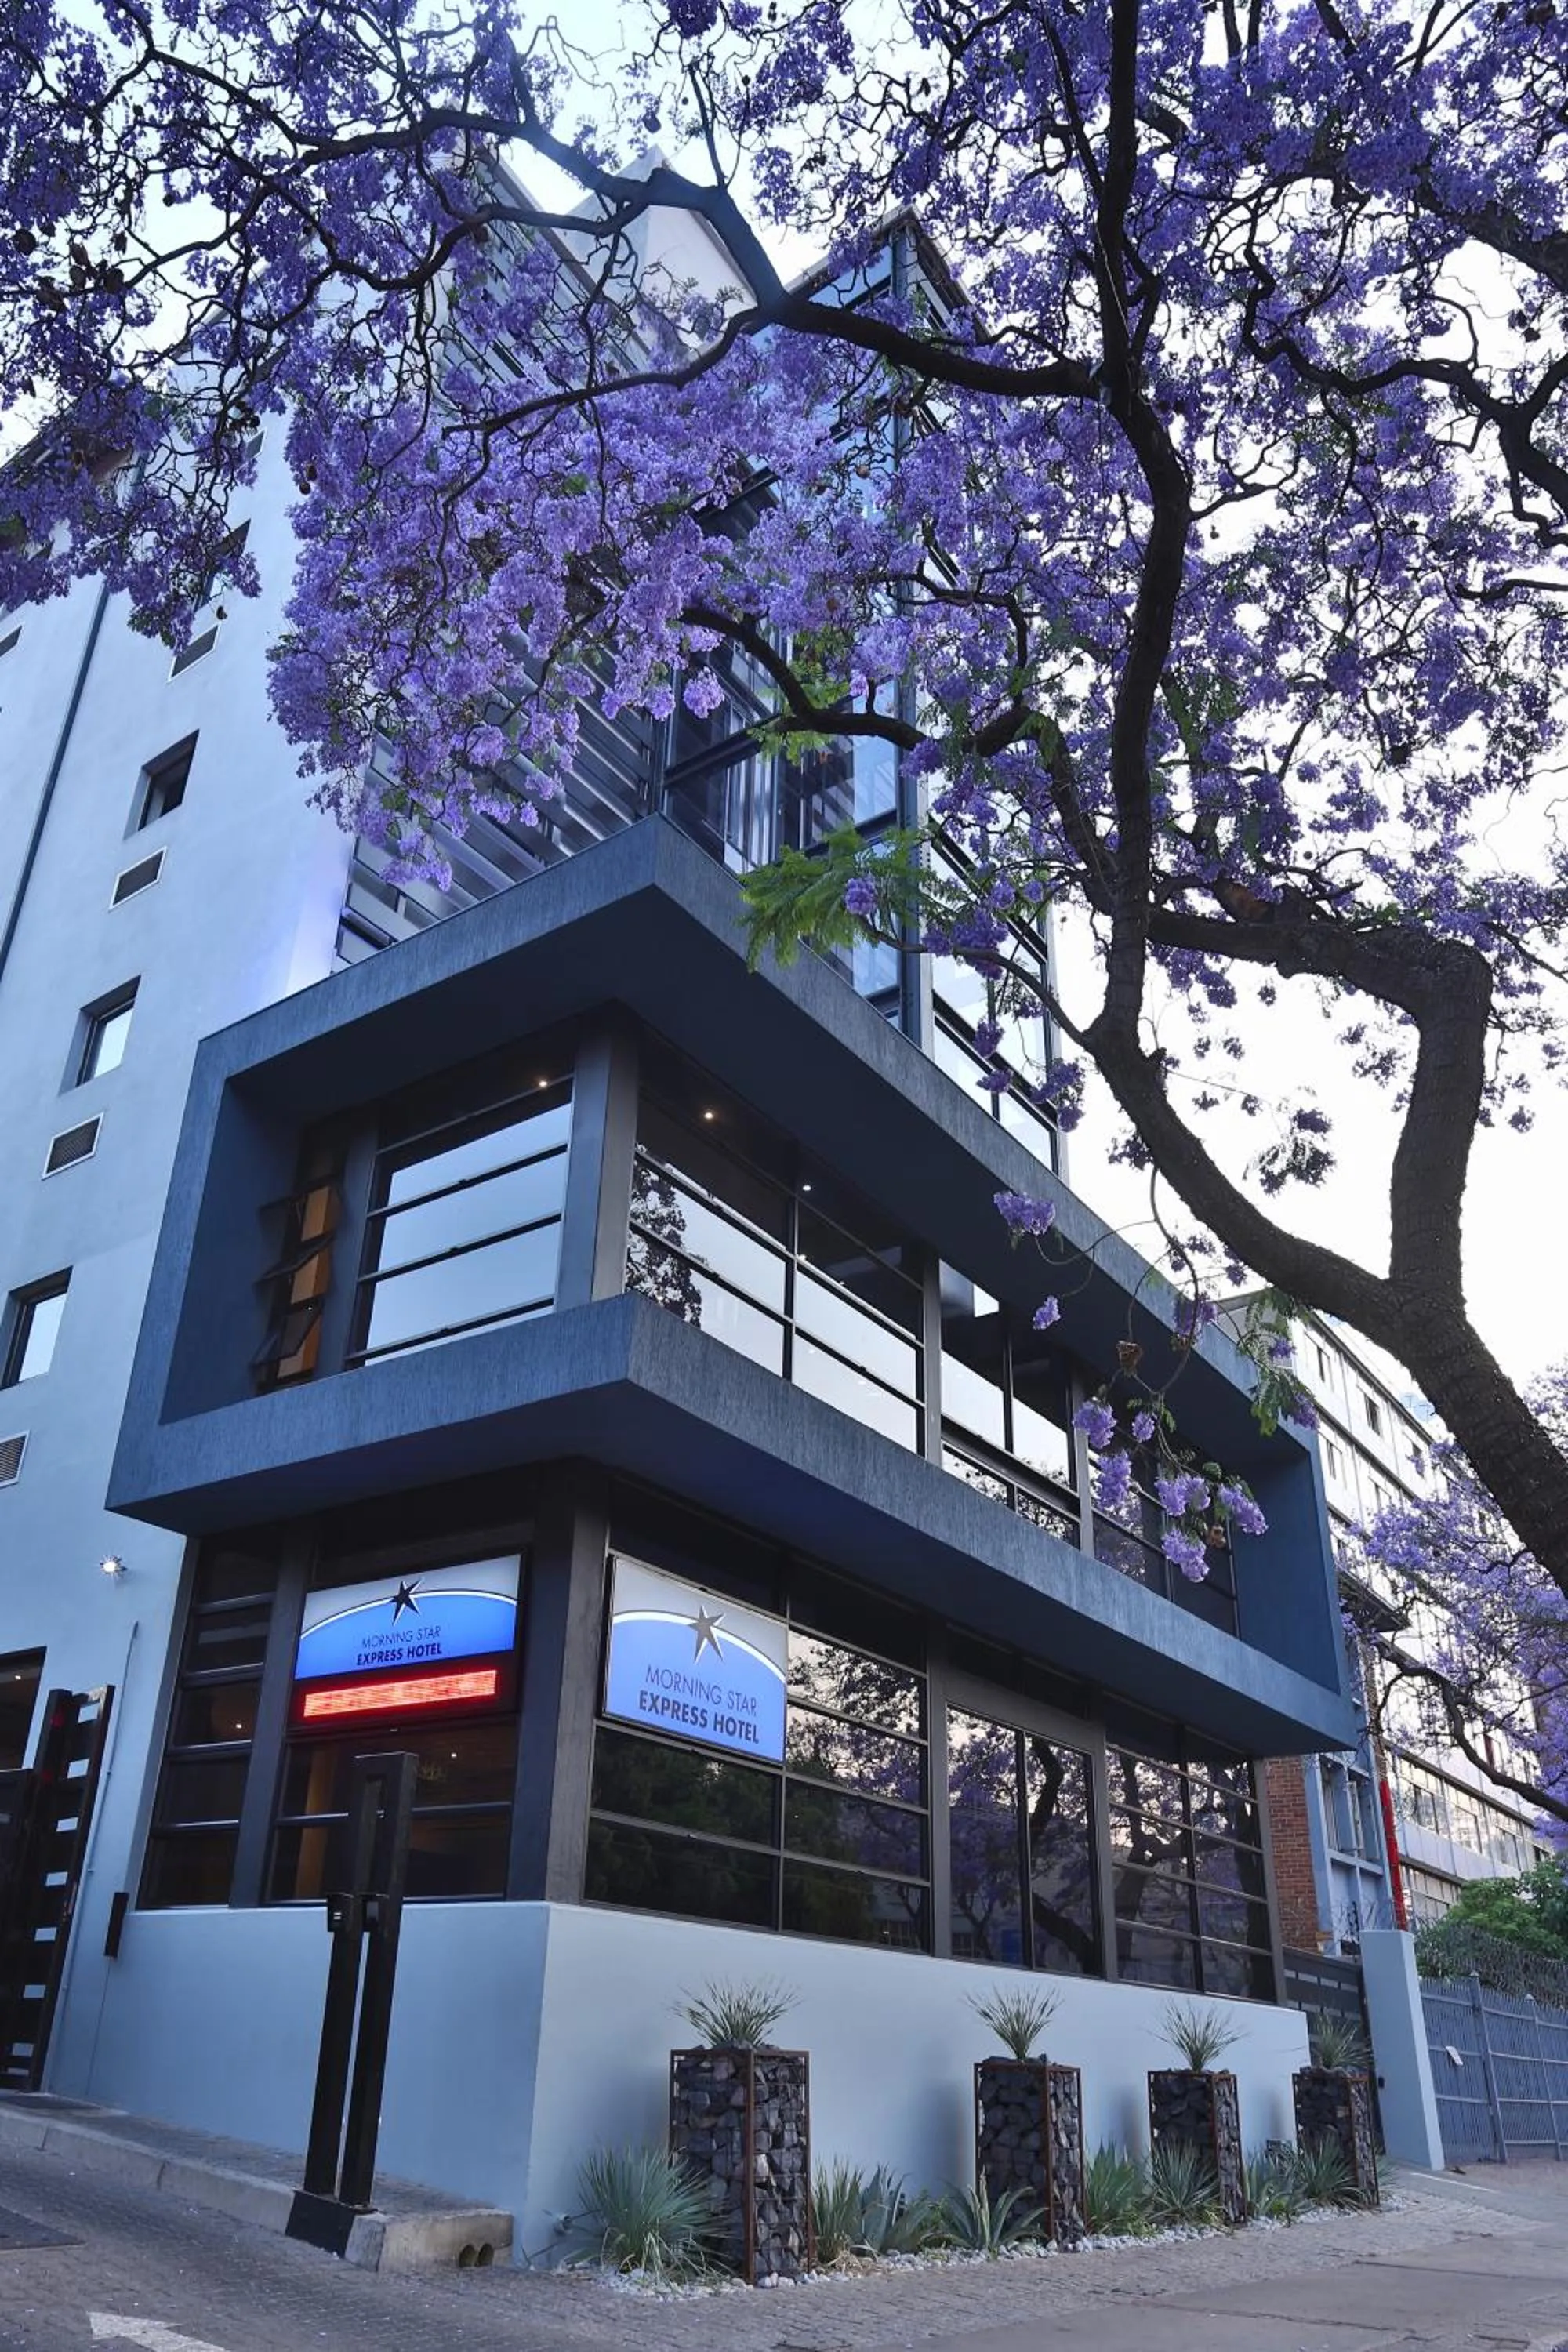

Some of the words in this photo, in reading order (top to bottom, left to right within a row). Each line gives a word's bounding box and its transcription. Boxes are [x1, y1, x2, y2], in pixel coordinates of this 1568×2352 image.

[357, 1649, 403, 1666] EXPRESS
[407, 1642, 442, 1659] HOTEL
[361, 1630, 413, 1649] MORNING
[416, 1624, 441, 1640] STAR
[646, 1664, 722, 1705] MORNING
[727, 1690, 757, 1717] STAR
[638, 1690, 708, 1728] EXPRESS
[713, 1711, 760, 1744] HOTEL
